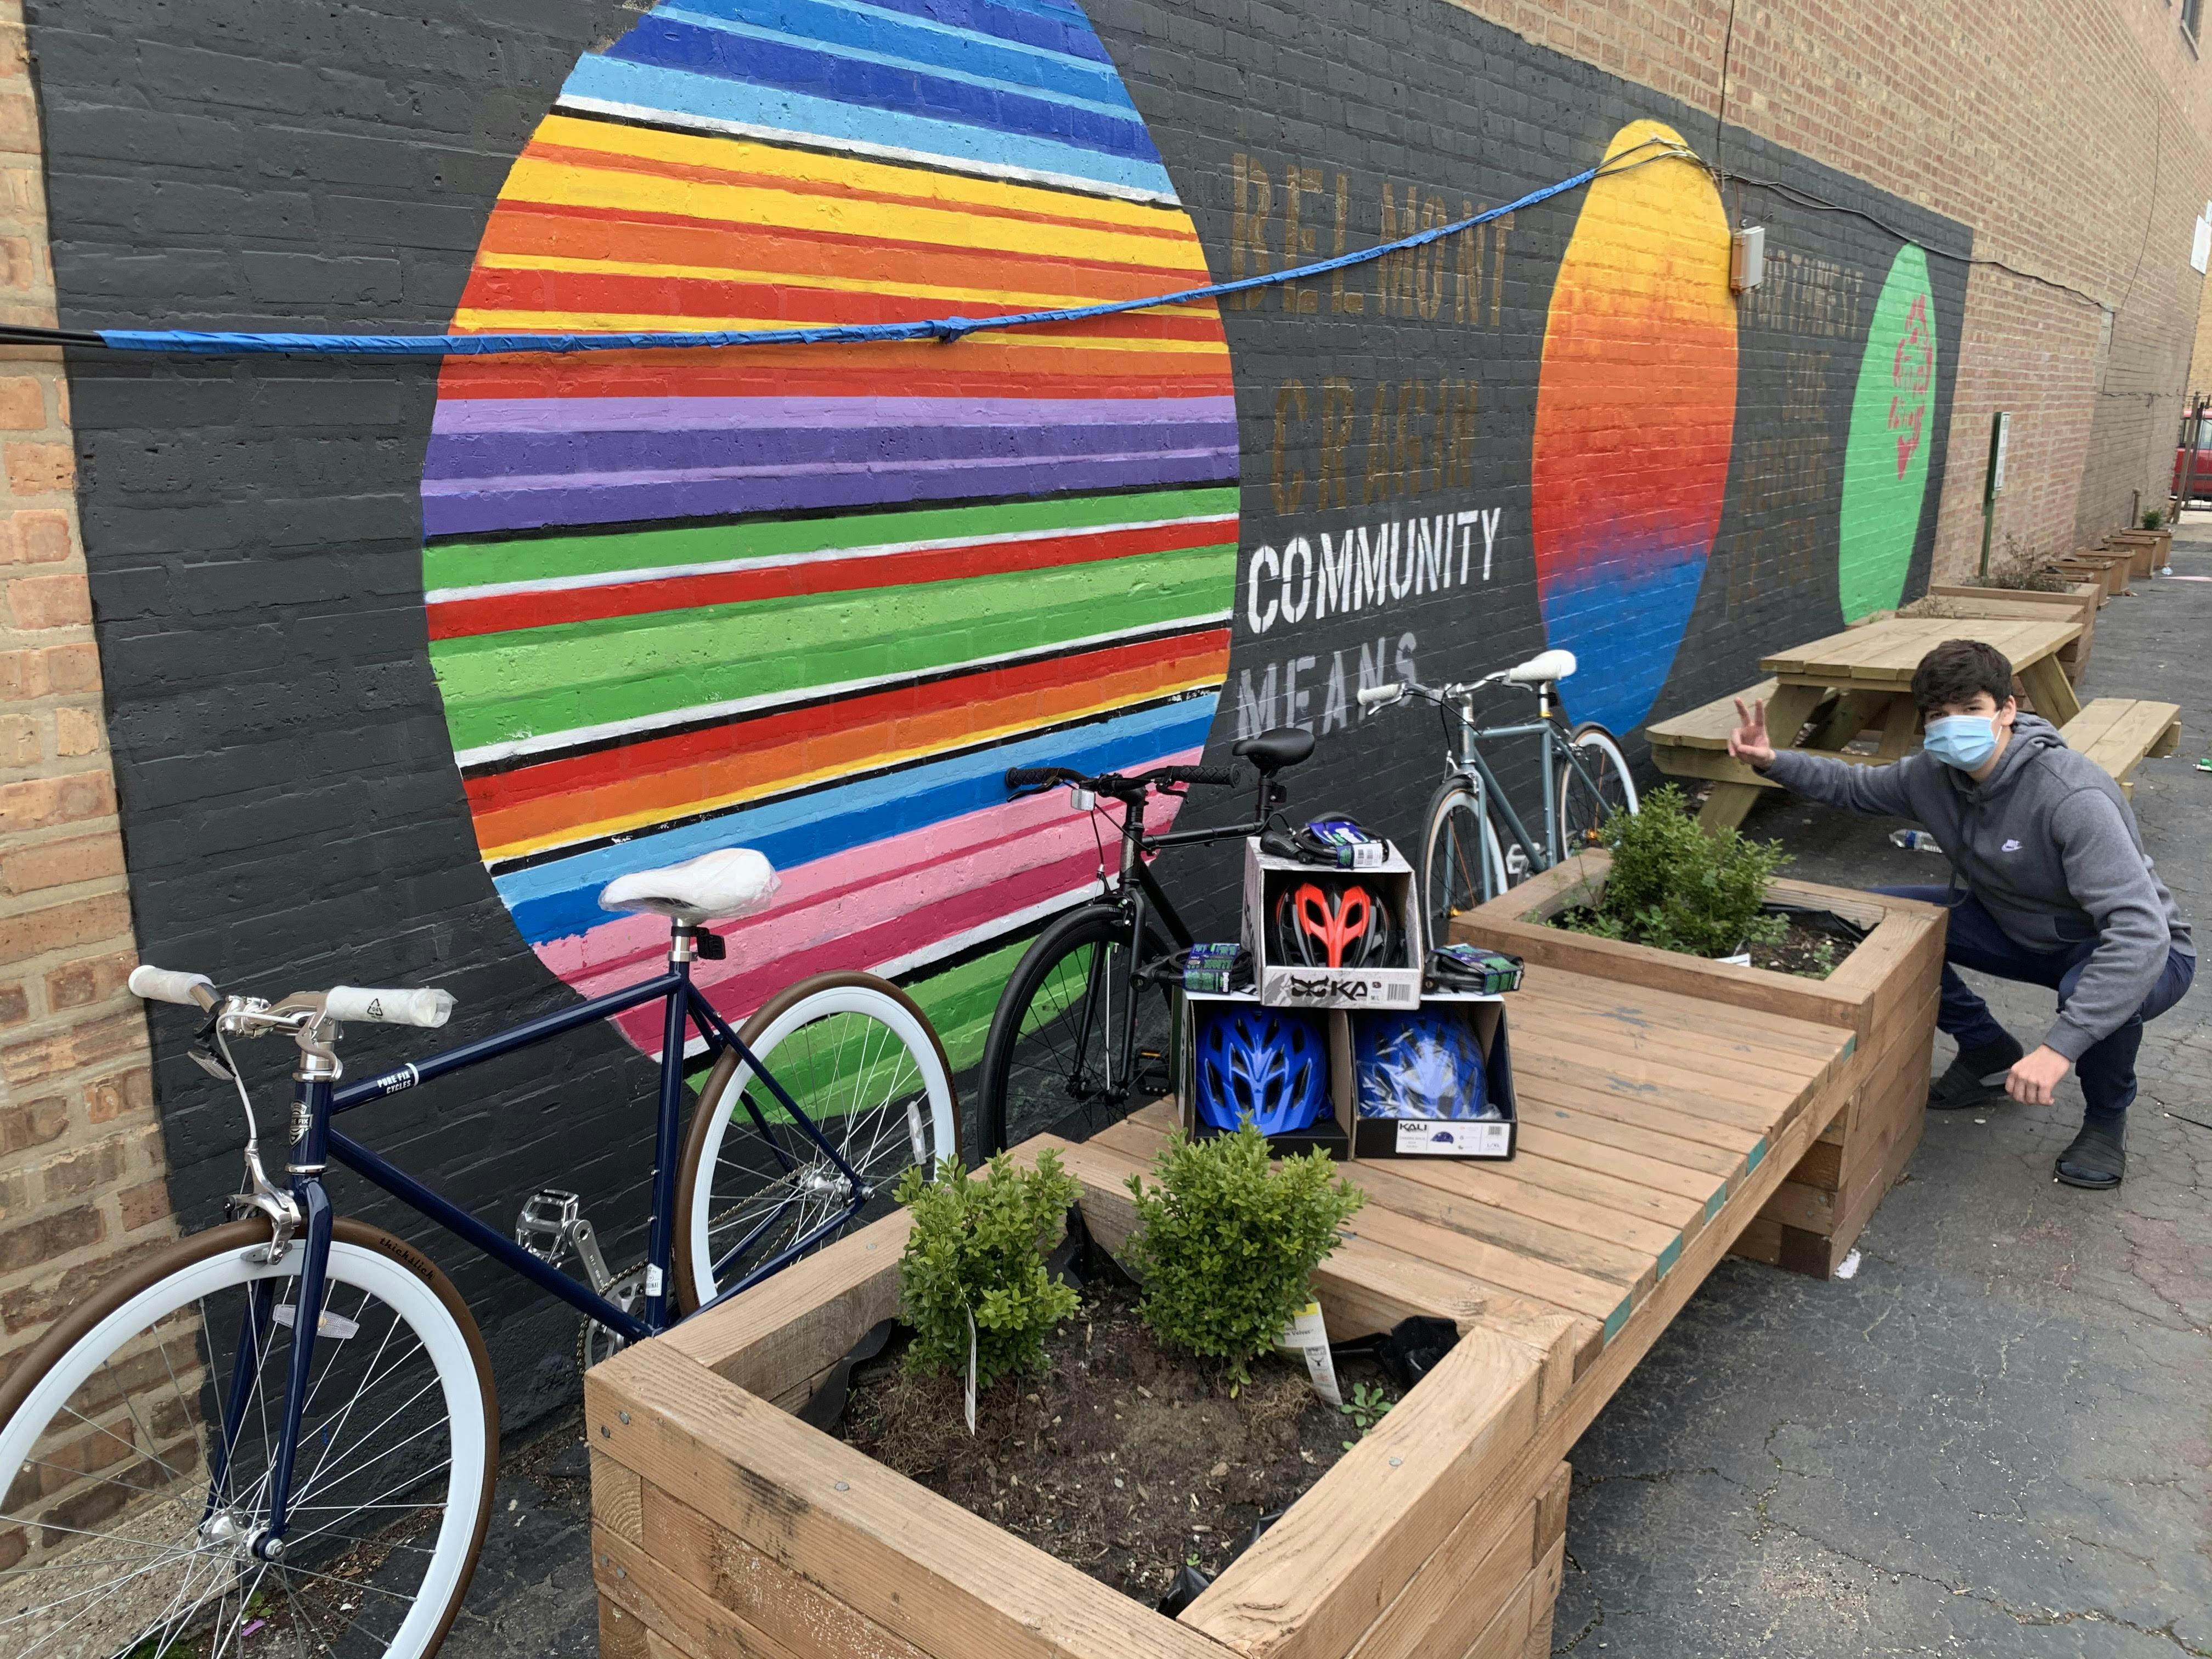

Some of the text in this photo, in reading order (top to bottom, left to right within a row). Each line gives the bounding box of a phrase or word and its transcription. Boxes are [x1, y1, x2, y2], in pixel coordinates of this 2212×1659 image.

[1229, 153, 1514, 326] BELMONT
[1271, 376, 1479, 516] CRAGIN
[1248, 507, 1501, 634] COMMUNITY
[1234, 632, 1417, 742] MEANS
[377, 1070, 411, 1088] PURE FIX
[386, 1080, 411, 1094] CYCLES
[1400, 1123, 1427, 1132] KALI
[379, 1237, 435, 1280] thickslick
